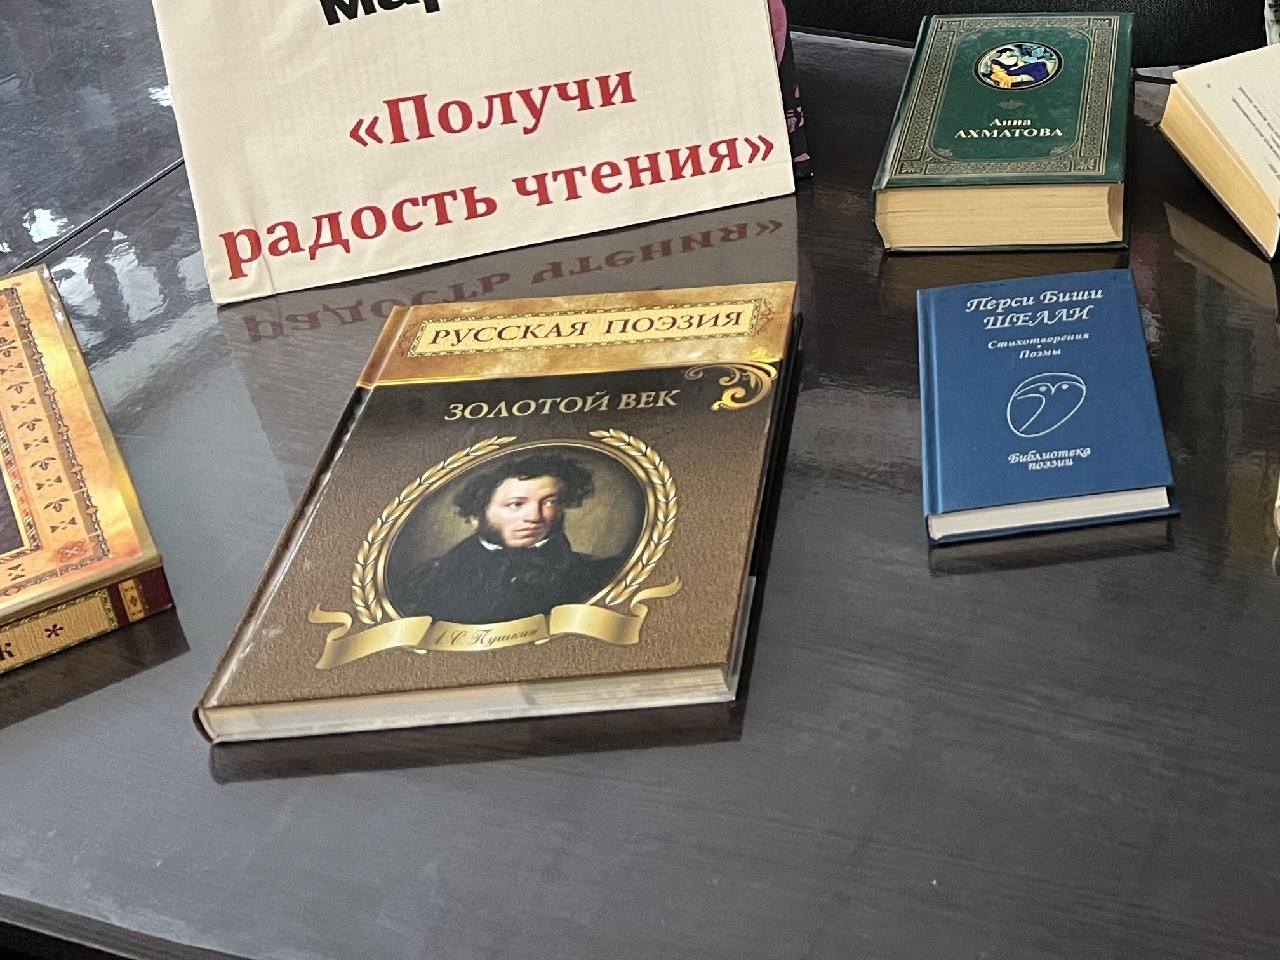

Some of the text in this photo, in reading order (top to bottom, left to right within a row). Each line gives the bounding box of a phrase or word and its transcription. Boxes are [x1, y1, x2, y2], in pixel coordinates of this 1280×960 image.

[348, 71, 638, 149] «Получи
[989, 117, 1032, 126] Анна
[954, 128, 1063, 138] АХМАТОВА
[219, 133, 775, 280] радость чтения»
[966, 288, 1103, 315] Перси Биши
[983, 305, 1094, 330] ШЕЛЛИ
[428, 311, 743, 346] РУССКАЯ ПОЭЗИЯ
[987, 331, 1090, 350] Стихотворения
[1019, 348, 1062, 359] Поэмы
[444, 388, 681, 421] ЗОЛОТОЙ ВЕК
[1008, 445, 1091, 464] Библиотека
[1028, 458, 1074, 471] поэзии
[468, 627, 540, 648] Пушкин
